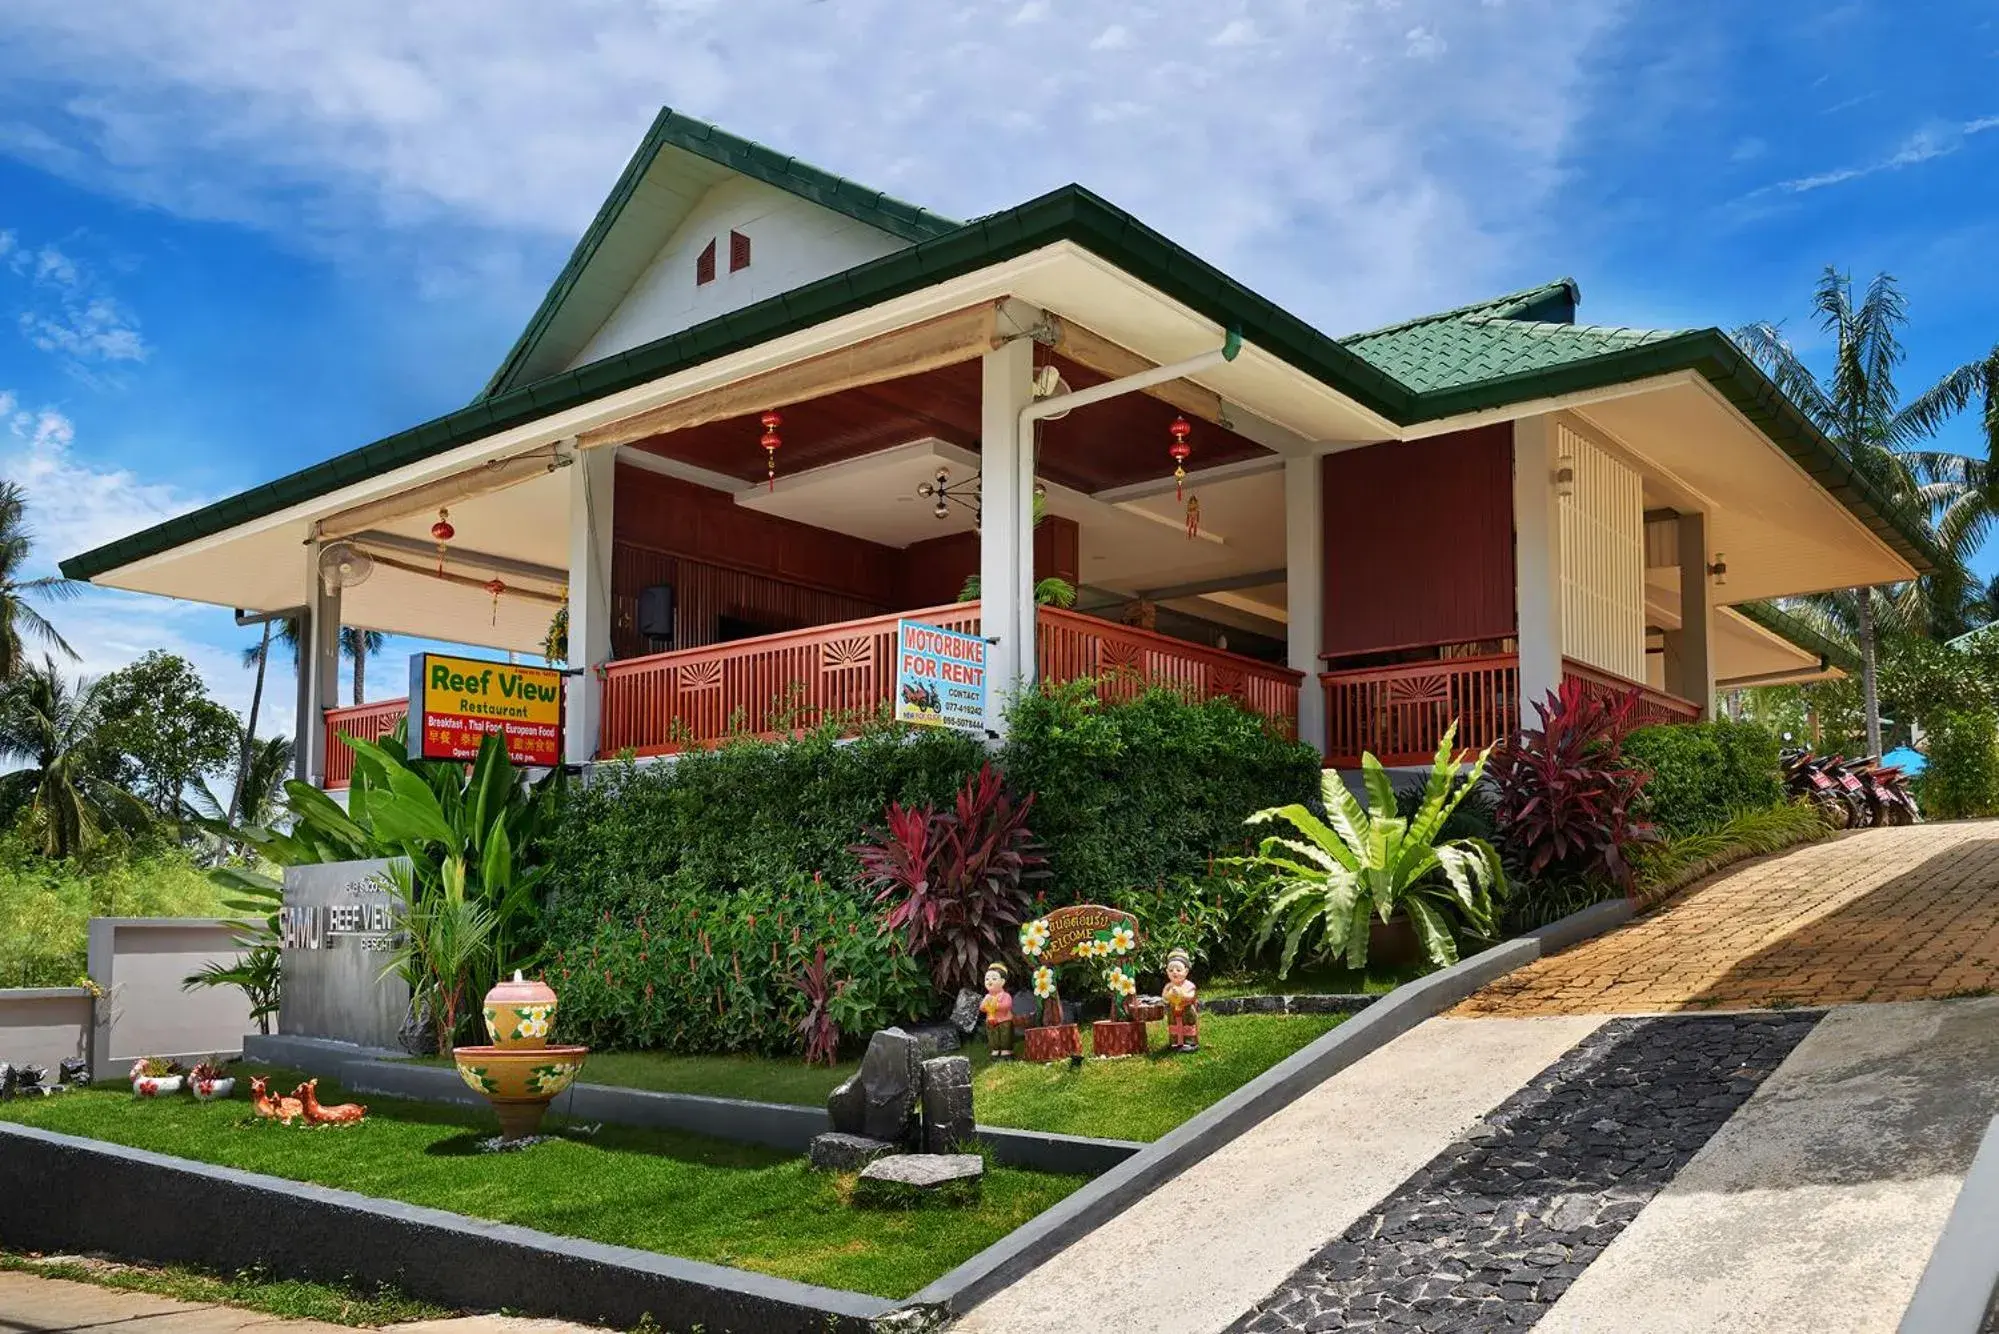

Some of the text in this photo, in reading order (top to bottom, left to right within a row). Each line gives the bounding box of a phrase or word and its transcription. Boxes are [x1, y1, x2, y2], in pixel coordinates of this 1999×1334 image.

[904, 626, 983, 663] MOTORBIKE
[431, 664, 557, 703] Reef View
[903, 655, 984, 687] FOR RENT
[460, 699, 528, 718] Restaurant
[948, 688, 980, 701] CONTACT
[428, 715, 463, 729] Breakfast
[469, 719, 485, 731] Thai
[505, 724, 537, 737] European
[538, 726, 555, 738] Food
[452, 748, 470, 758] Open
[278, 903, 393, 950] SAMUI REEF VIEW
[1041, 928, 1095, 960] WELCOME
